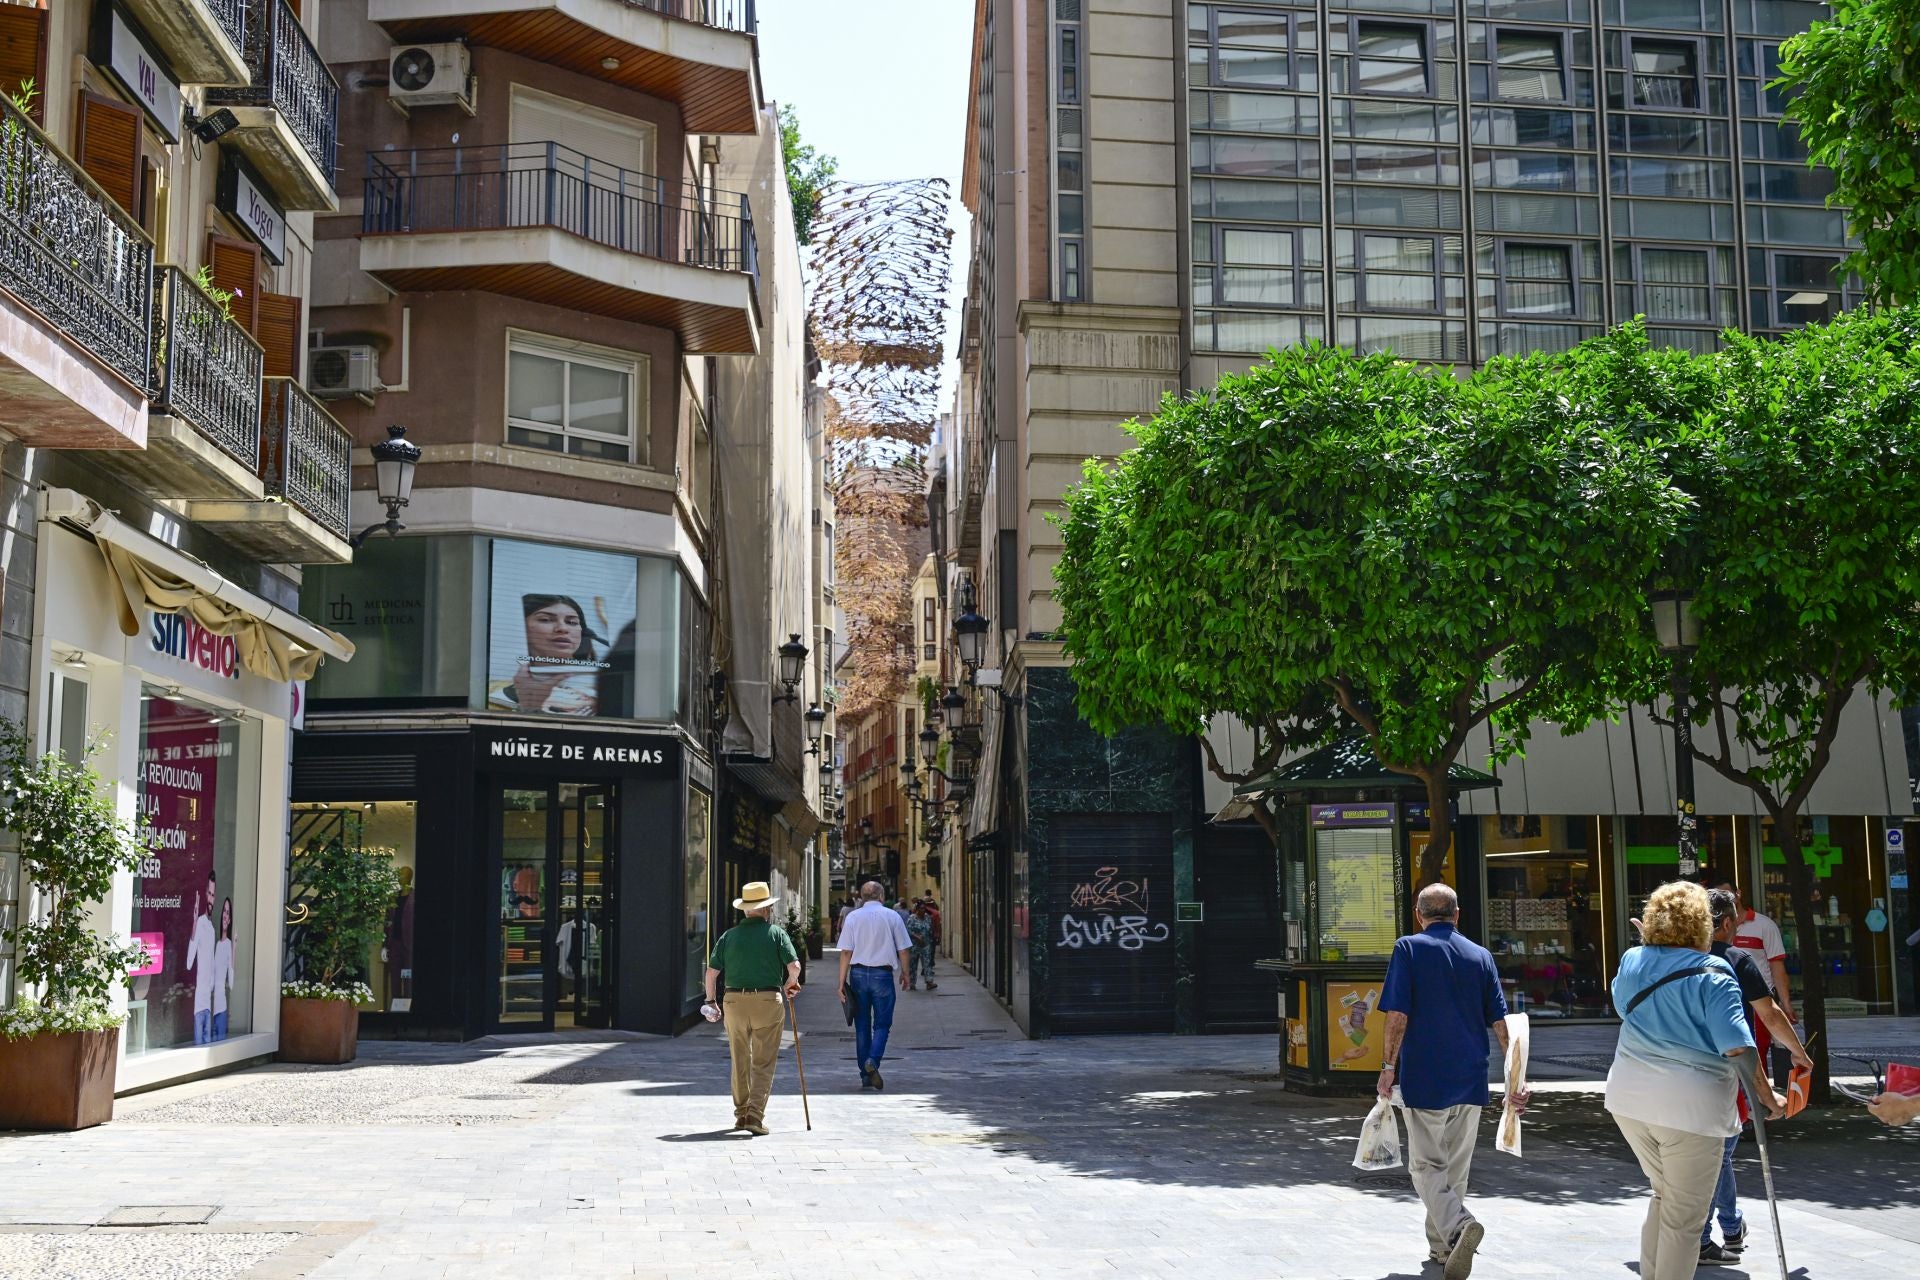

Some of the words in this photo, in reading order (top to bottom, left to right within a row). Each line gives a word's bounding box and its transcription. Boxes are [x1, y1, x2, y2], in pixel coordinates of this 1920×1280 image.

[138, 54, 156, 106] YA!
[248, 186, 274, 240] Yoga
[364, 600, 422, 609] MEDICINA
[535, 655, 561, 664] ácido
[561, 658, 611, 668] hialurónico
[491, 737, 554, 759] NÚÑEZ
[561, 745, 585, 760] DE
[593, 747, 663, 764] ARENAS
[150, 762, 203, 792] REVOLUCIÓN
[150, 794, 161, 816] LA
[144, 894, 150, 908] la
[150, 894, 182, 911] experiencia!
